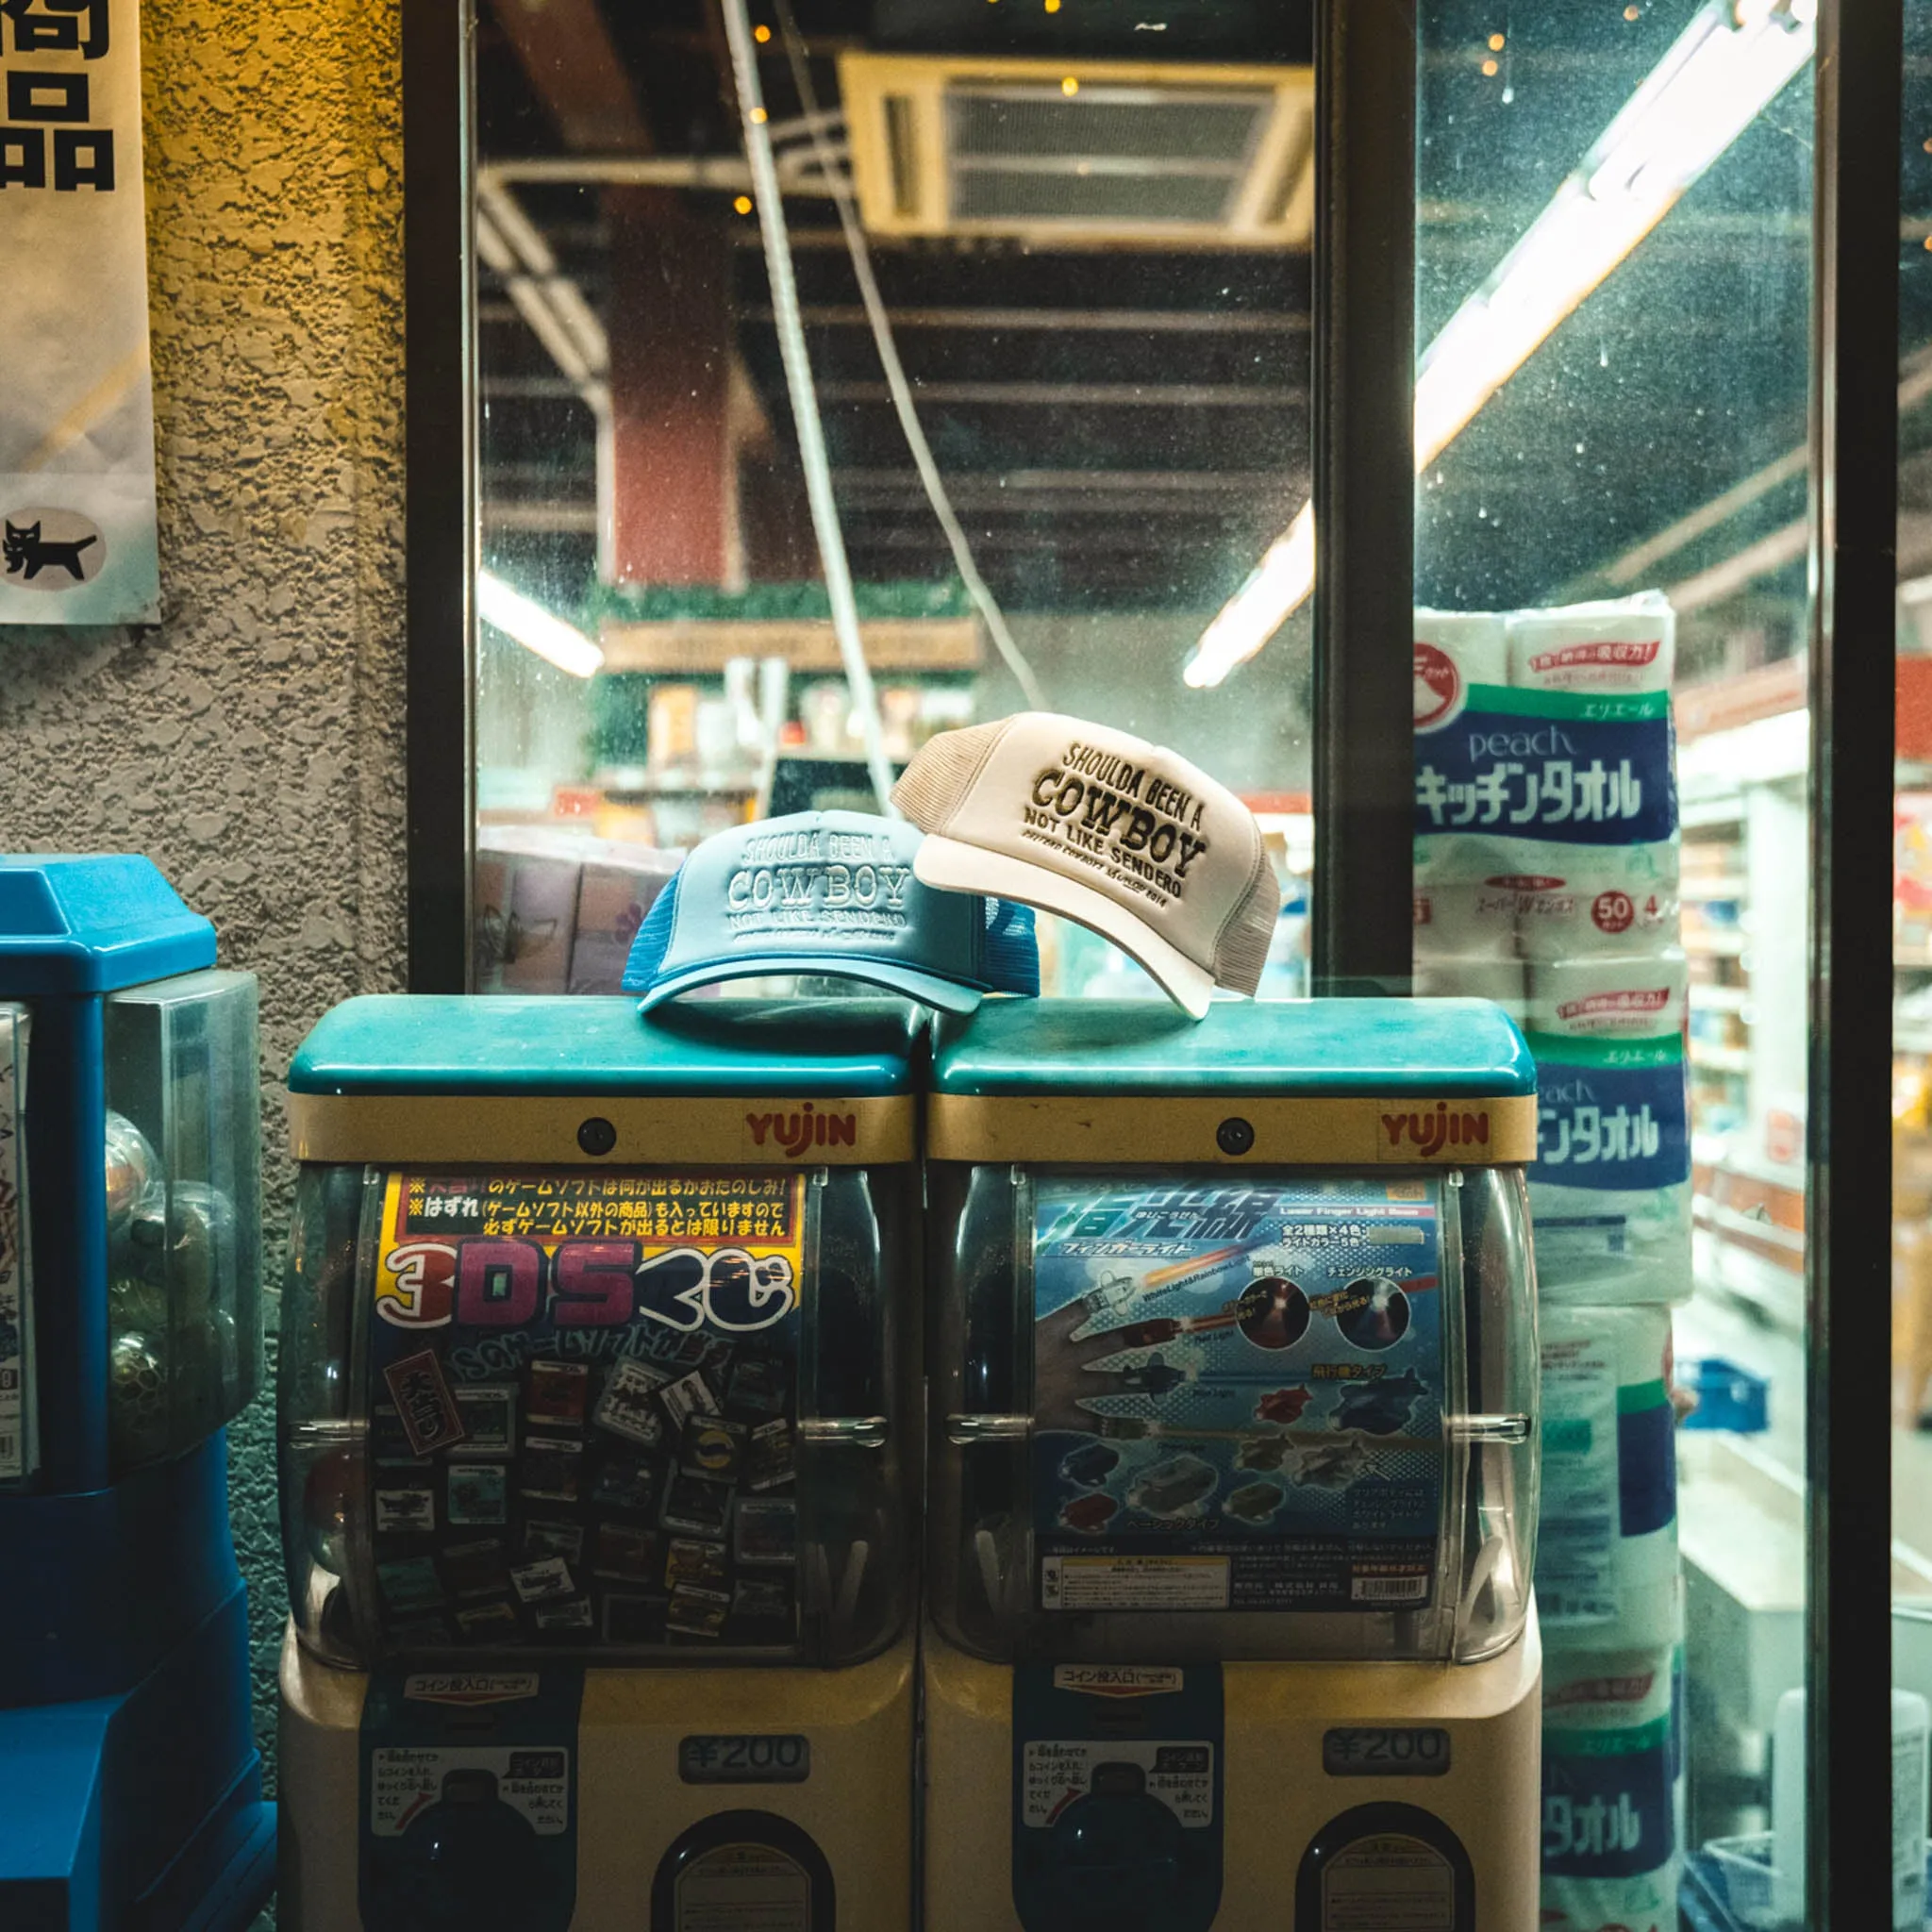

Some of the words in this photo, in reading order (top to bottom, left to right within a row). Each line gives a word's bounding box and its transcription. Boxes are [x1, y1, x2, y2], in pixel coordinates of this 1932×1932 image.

[1468, 724, 1574, 762] peach
[1062, 741, 1145, 799] SHOULDA
[1145, 778, 1191, 823] BEEN
[1191, 801, 1206, 833] A
[1415, 760, 1641, 826] キッチンタオル
[1032, 768, 1208, 879] COWBOY
[741, 830, 821, 864] SHOULDA
[828, 832, 874, 860] BEEN
[1024, 808, 1060, 834] NOT
[1066, 824, 1104, 855] LIKE
[1110, 847, 1182, 900] SENDERO
[727, 864, 911, 911] COWBOY
[727, 912, 764, 930] NOT
[771, 909, 814, 925] LIKE
[1597, 897, 1628, 920] 50
[1643, 895, 1657, 916] 4
[484, 1218, 786, 1238] 必ずゲームソフトが出るとは限りません
[1062, 1241, 1197, 1257] フィンガーライト
[689, 1737, 802, 1768] ¥200
[1332, 1731, 1441, 1761] ¥200
